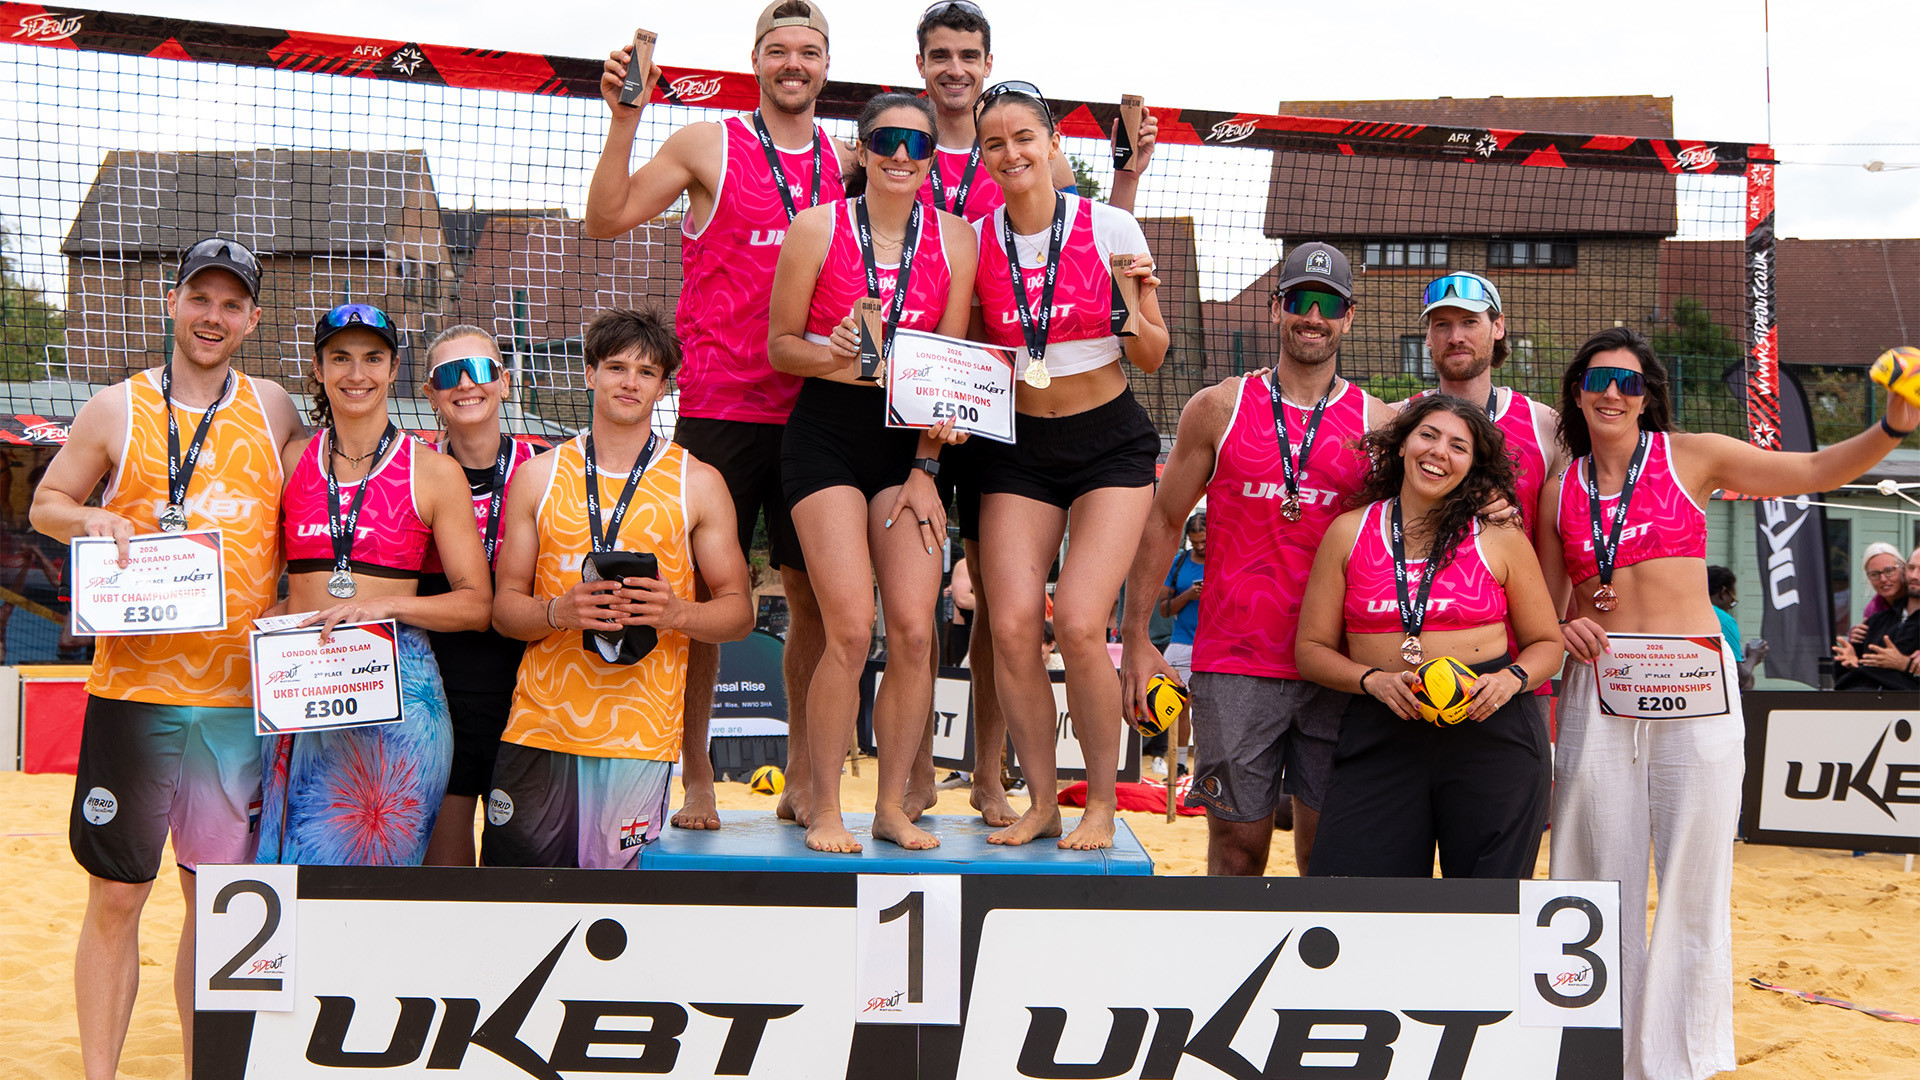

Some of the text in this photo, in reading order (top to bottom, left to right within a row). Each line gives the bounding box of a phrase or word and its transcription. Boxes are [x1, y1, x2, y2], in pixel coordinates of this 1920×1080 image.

[352, 45, 383, 57] AFK
[1447, 132, 1471, 143] AFK
[1750, 195, 1760, 220] AFK
[1047, 262, 1056, 286] UKBT
[895, 288, 905, 312] UKBT
[1019, 304, 1029, 328] UKBT
[1041, 306, 1049, 330] UKBT
[916, 351, 992, 373] LONDON GRAND SLAM
[947, 348, 962, 357] 2026
[952, 377, 967, 387] PLACE
[974, 381, 1007, 396] UKBT
[915, 386, 992, 408] UKBT CHAMPIONS
[932, 401, 979, 423] £500
[189, 442, 200, 464] UKBT
[1628, 463, 1639, 485] UKBT
[347, 510, 357, 533] UKBT
[614, 502, 627, 524] UKBT
[1616, 503, 1627, 525] UKBT
[297, 524, 375, 539] UKT
[103, 553, 195, 567] LONON GRAND SLAM
[139, 546, 159, 554] 2026
[1606, 543, 1616, 566] UKBT
[173, 568, 213, 583] UKBT
[92, 588, 206, 603] UKBT CHAMPIONSHIPS
[123, 604, 178, 623] £300
[1415, 602, 1425, 626] UKBT
[282, 643, 371, 659] LONDON GRAND SLAM
[1614, 652, 1647, 660] LONDON
[324, 671, 343, 679] PLACE
[351, 660, 390, 675] UKBT
[1679, 666, 1718, 679] UKBT
[273, 680, 384, 700] UKBT CHAMPIONSHIPS
[713, 681, 766, 693] nsal Rise
[1609, 682, 1712, 693] UKBT CHAMPIONSHIPS
[304, 697, 358, 719] £300
[1637, 696, 1687, 711] £200
[711, 726, 743, 734] we are
[1785, 719, 1920, 822] UKB
[625, 836, 642, 848] ENG
[209, 880, 284, 992] 2
[879, 891, 923, 1004] 1
[1534, 896, 1607, 1009] 3
[306, 918, 804, 1080] UKBT
[1016, 926, 1514, 1080] UKBT
